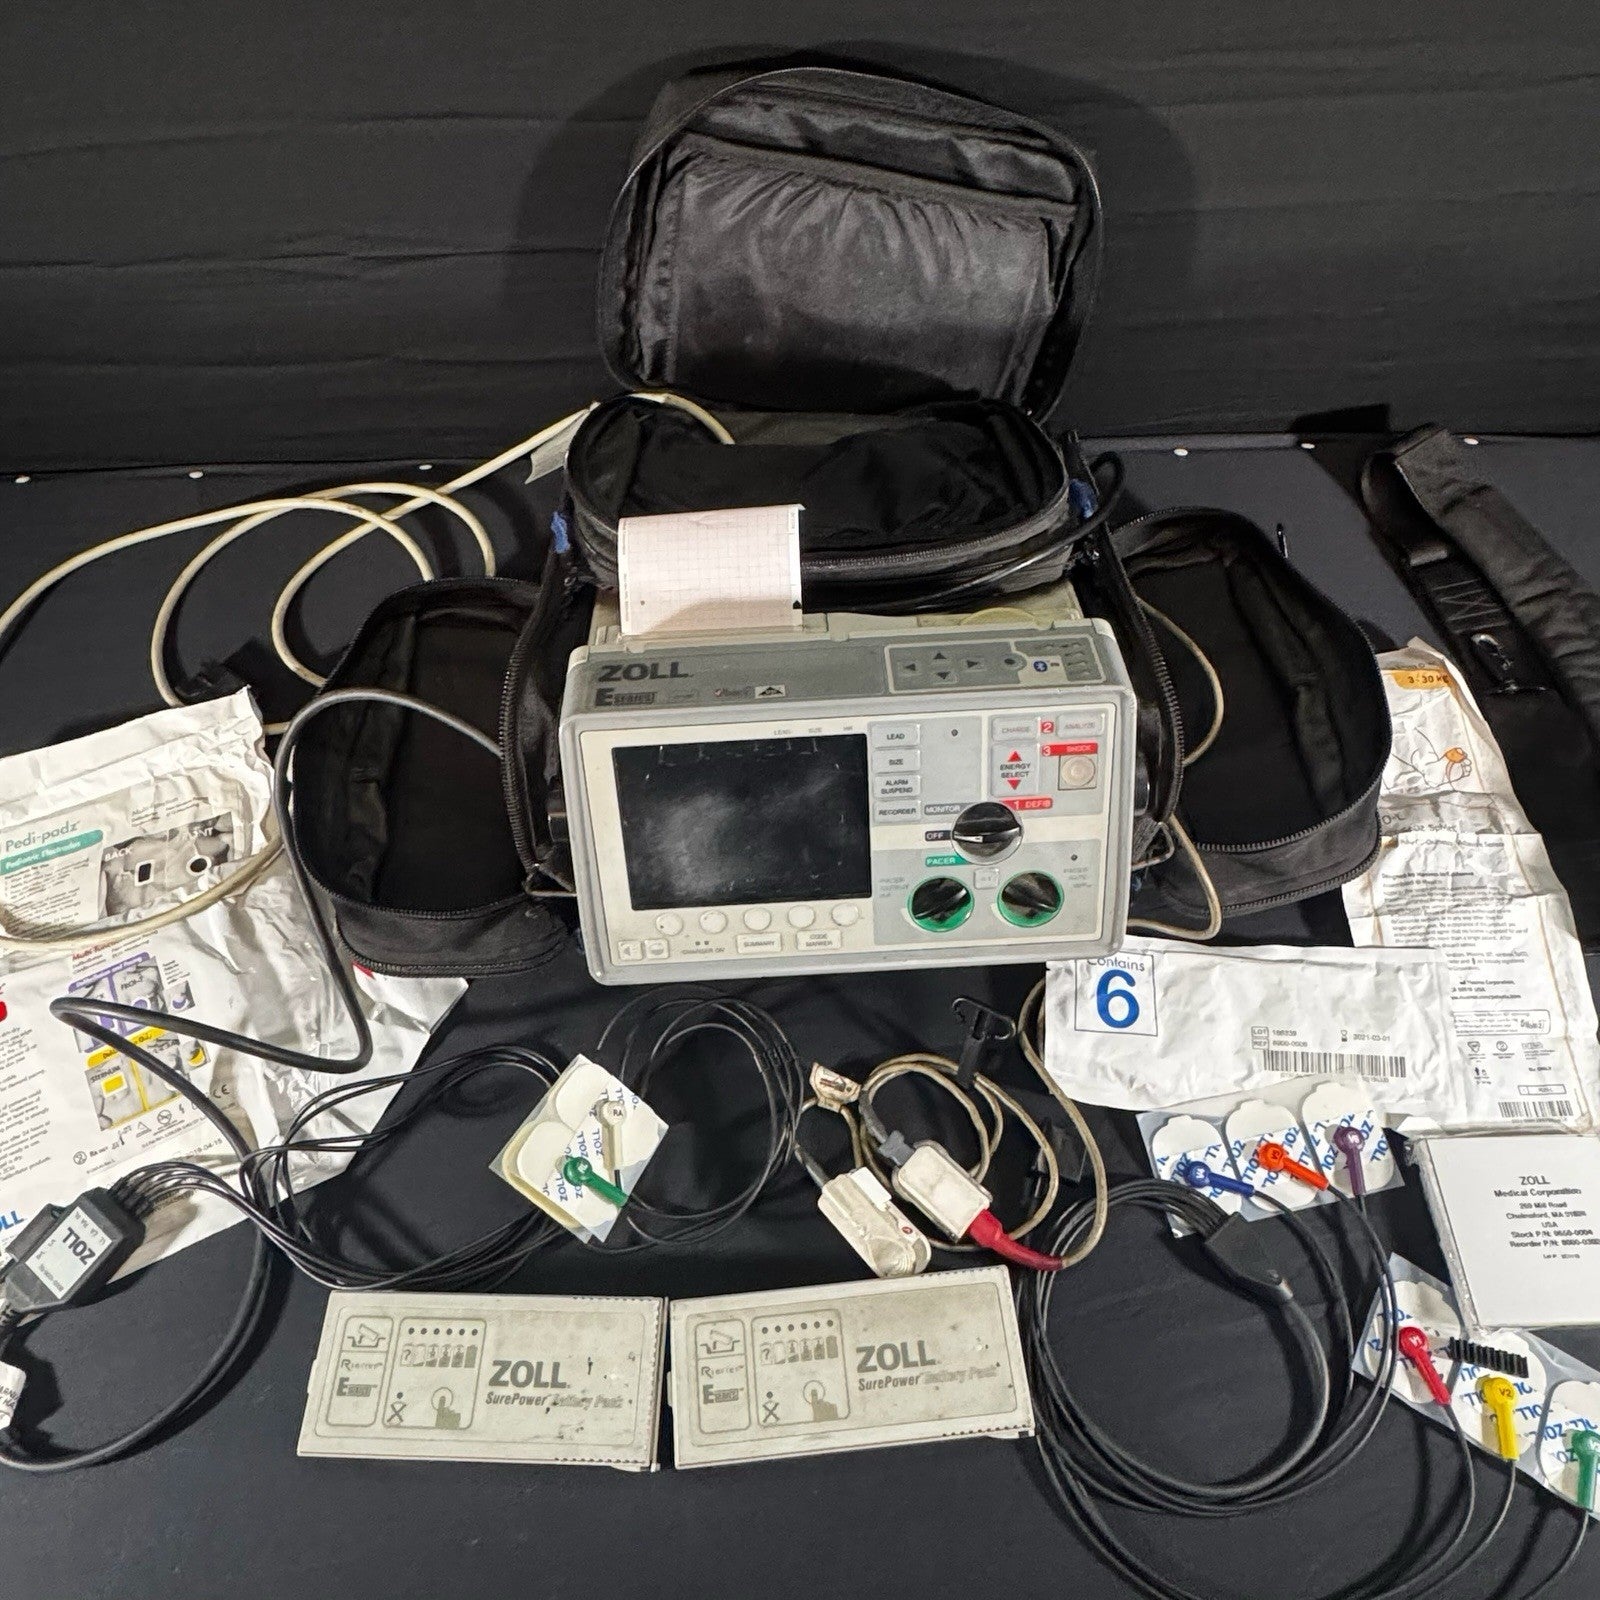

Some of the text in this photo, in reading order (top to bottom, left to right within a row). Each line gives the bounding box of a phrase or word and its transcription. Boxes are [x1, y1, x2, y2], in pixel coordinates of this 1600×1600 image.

[599, 662, 690, 682] ZOLL
[1043, 722, 1052, 733] 2
[1042, 746, 1050, 757] 3
[888, 758, 904, 766] SIZE
[1000, 762, 1031, 771] ENERGY
[1001, 770, 1030, 778] SELECT
[885, 779, 909, 787] ALARM
[881, 787, 914, 795] SUSPEND
[925, 805, 961, 814] MONITOR
[1013, 800, 1020, 810] 1
[878, 808, 917, 816] RECORDER
[5, 821, 78, 851] Pedi-padz
[926, 831, 945, 840] OFF
[105, 846, 133, 861] BACK
[926, 857, 957, 866] PACER
[743, 940, 775, 948] SUMMARY
[1095, 969, 1140, 1029] 6
[613, 1108, 624, 1117] RA
[1519, 1175, 1550, 1186] ZOLL
[555, 1175, 569, 1202] ZOLL
[1494, 1188, 1582, 1198] Medical Corporation
[62, 1226, 96, 1266] ZOLL
[855, 1340, 936, 1373] ZOLL
[488, 1360, 567, 1389] ZOLL
[858, 1374, 920, 1391] SurePower
[1499, 1388, 1512, 1398] V2
[485, 1391, 548, 1407] SurePower
